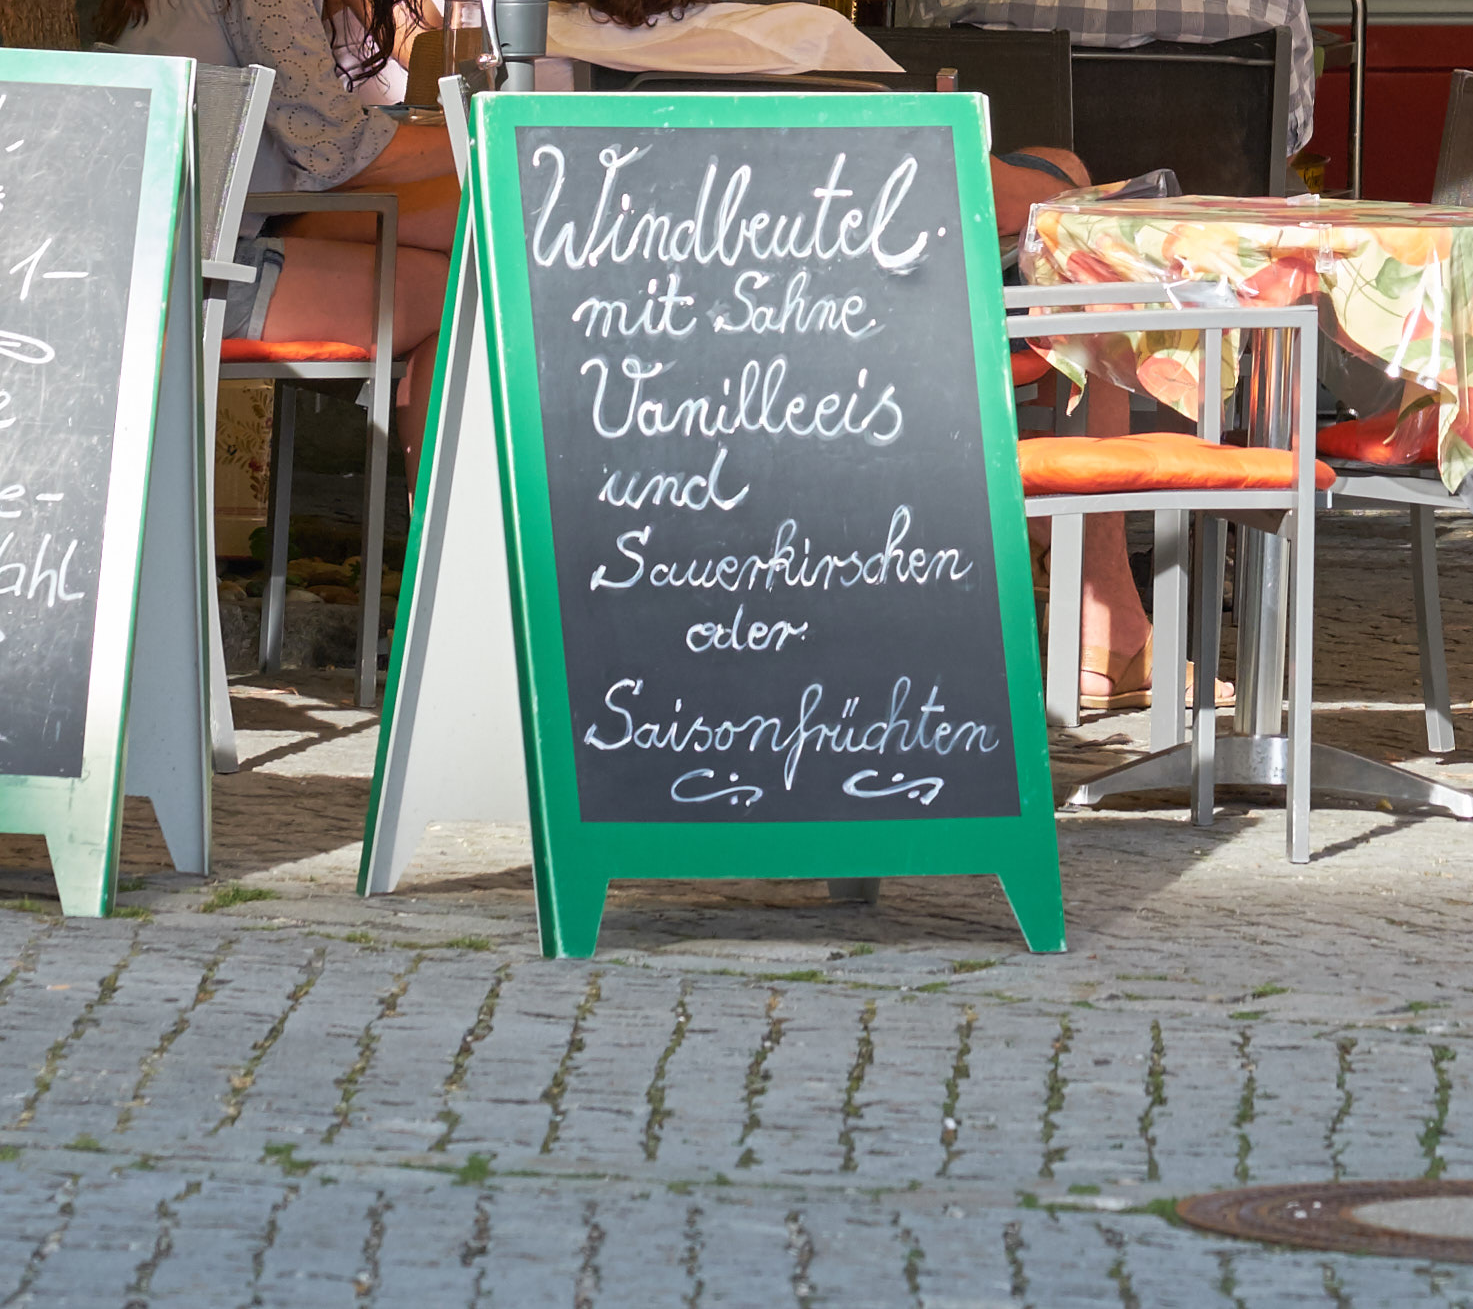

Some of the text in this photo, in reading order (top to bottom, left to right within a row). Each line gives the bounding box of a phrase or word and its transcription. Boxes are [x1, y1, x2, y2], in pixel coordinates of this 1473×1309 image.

[531, 144, 930, 271] Windbeutel
[572, 271, 885, 339] mit Sahne
[579, 356, 904, 444] Vanilleeis
[599, 448, 751, 512] und
[589, 503, 975, 592] Sauerkirschen
[684, 605, 809, 653] oder
[583, 675, 1000, 792] Saisonfrüchten
